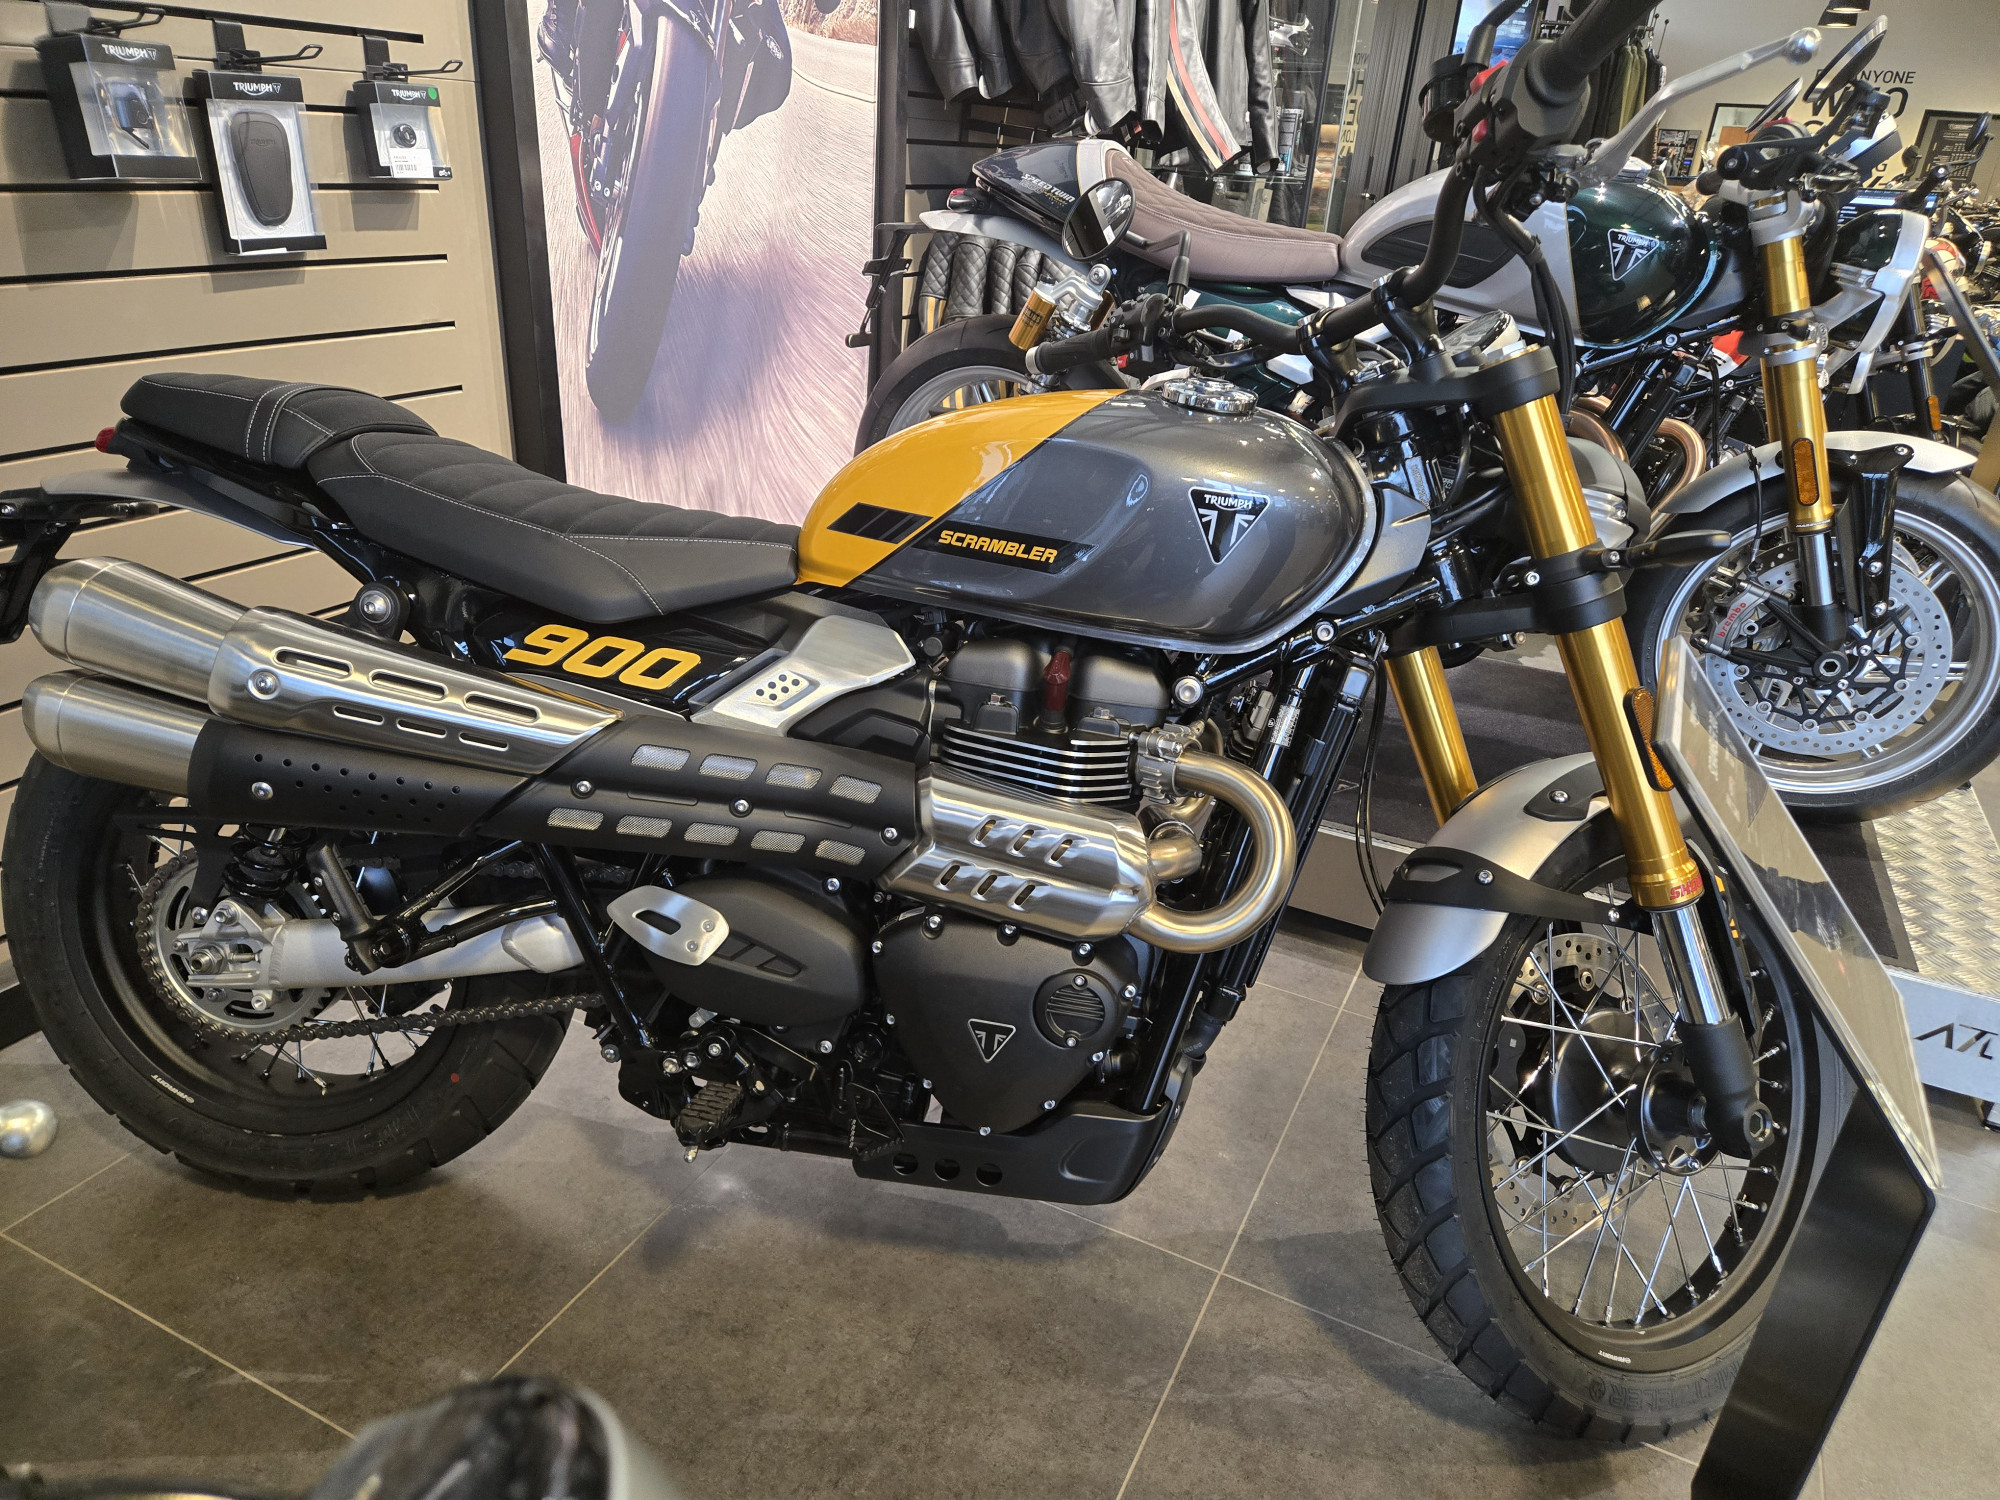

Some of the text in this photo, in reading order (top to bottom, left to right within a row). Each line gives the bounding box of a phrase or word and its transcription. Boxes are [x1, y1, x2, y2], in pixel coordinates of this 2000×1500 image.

[101, 44, 148, 61] TRIUMPH
[1859, 70, 1916, 84] NYONE
[232, 81, 274, 96] TRIUMPH
[391, 88, 421, 101] TRIUMPH
[1021, 173, 1053, 190] SPEED
[1050, 186, 1076, 203] TWIN
[1617, 232, 1650, 247] TRIUMPH
[1203, 493, 1254, 511] TRIUMPH
[938, 529, 1059, 564] SCRAMBLER
[1715, 602, 1747, 638] brembo
[503, 623, 702, 691] 900
